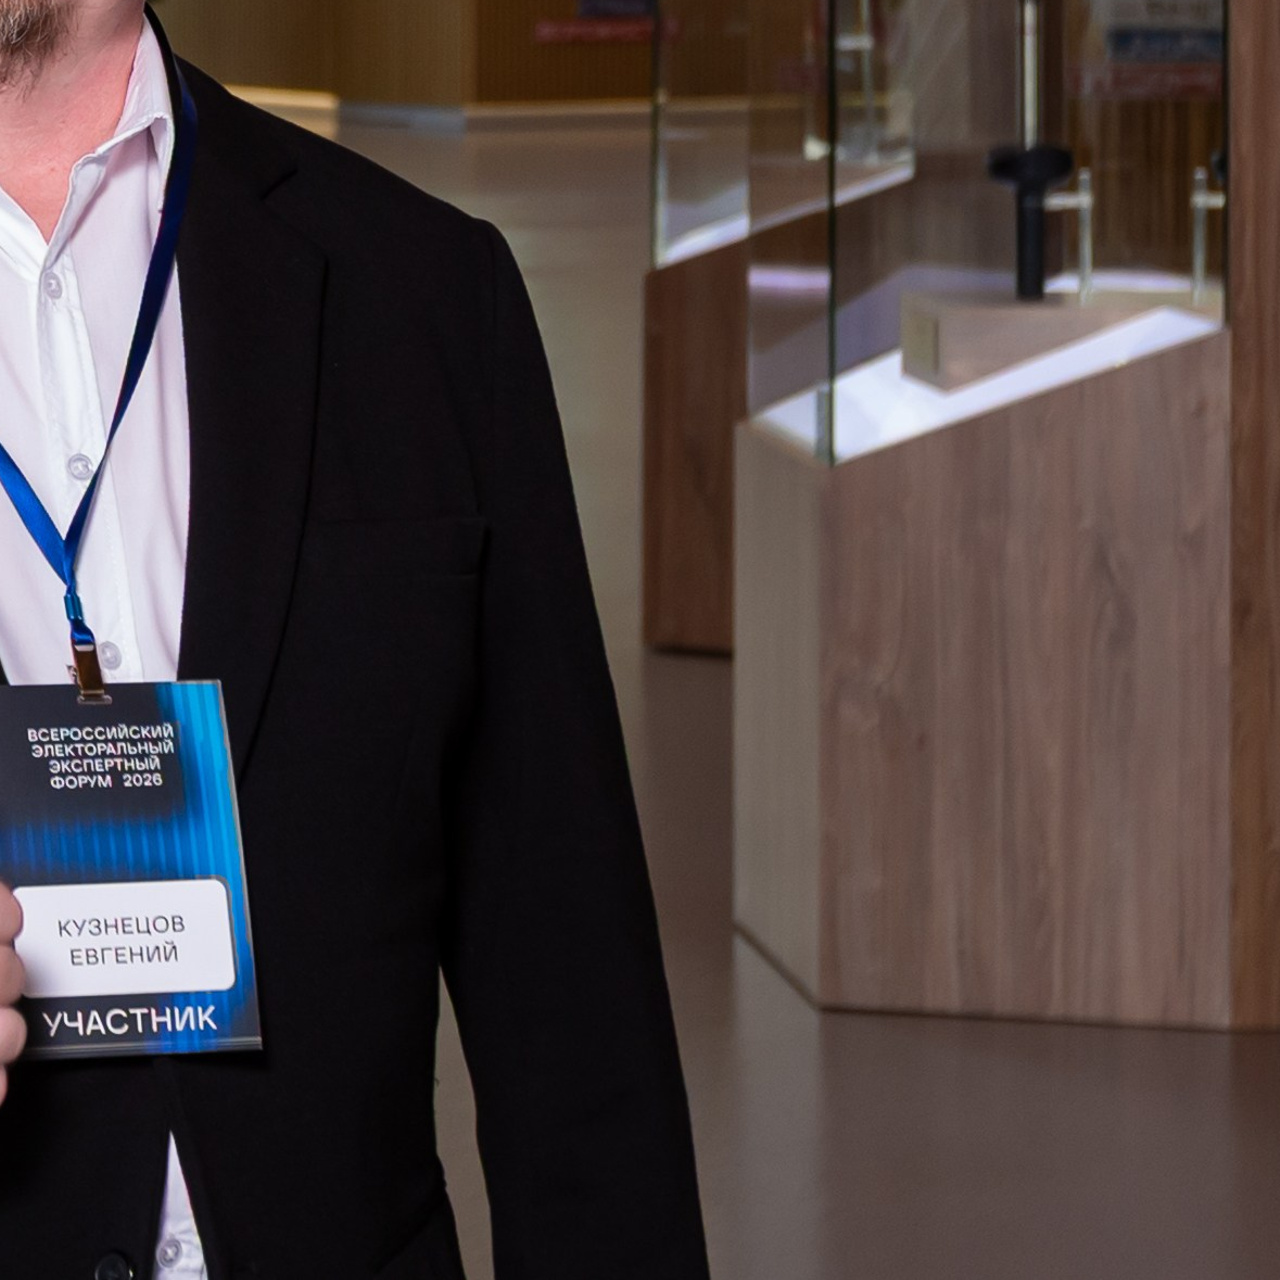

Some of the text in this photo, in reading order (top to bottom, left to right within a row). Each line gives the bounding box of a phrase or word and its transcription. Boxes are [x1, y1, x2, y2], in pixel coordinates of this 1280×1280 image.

[27, 723, 174, 742] ВСЕРОССИЙСКИЙ
[31, 739, 174, 758] ЭЛЕКТОРАЛЬНЫЙ
[49, 755, 160, 774] ЭКСПЕРТНЫЙ
[50, 773, 163, 790] ФОРУМ 2026
[58, 915, 186, 937] КУЗНЕЦОВ
[70, 941, 179, 966] ЕВГЕНИЙ
[42, 1005, 218, 1037] УЧАСТНИК
